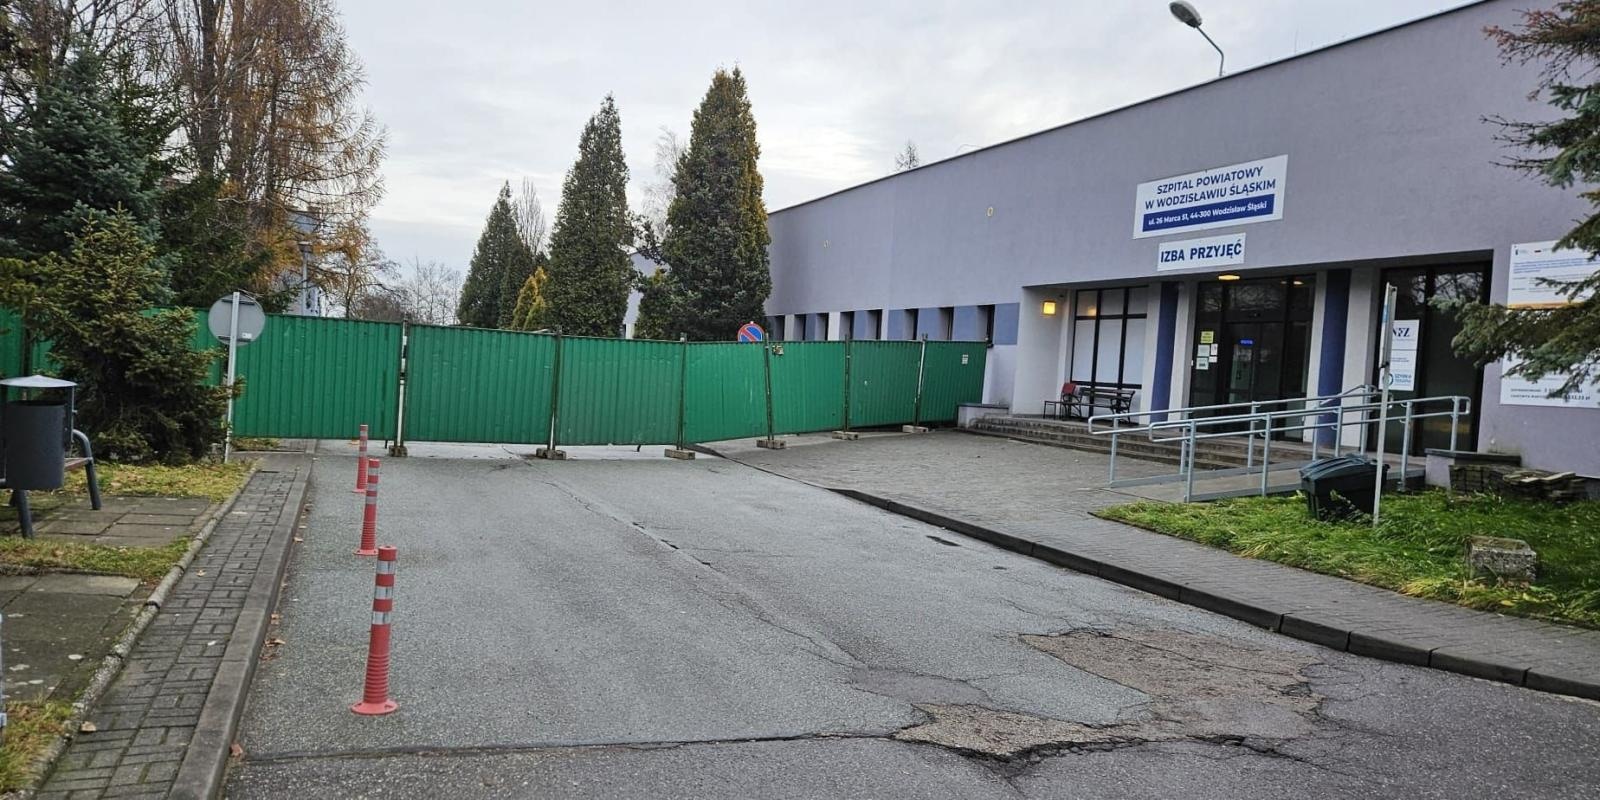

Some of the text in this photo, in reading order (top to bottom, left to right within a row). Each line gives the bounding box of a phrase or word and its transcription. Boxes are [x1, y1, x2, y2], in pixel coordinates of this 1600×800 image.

[1157, 166, 1264, 195] SZPITAL POWIATOWY
[1145, 179, 1277, 210] W WODZISŁAWIU ŚLĄSKIM
[1156, 216, 1163, 225] 26
[1163, 214, 1181, 224] Marca
[1190, 209, 1212, 220] 44-300
[1212, 204, 1247, 217] Wodzisław
[1247, 200, 1268, 213] Śląski
[1160, 239, 1242, 263] IZBA PRZYJĘĆ
